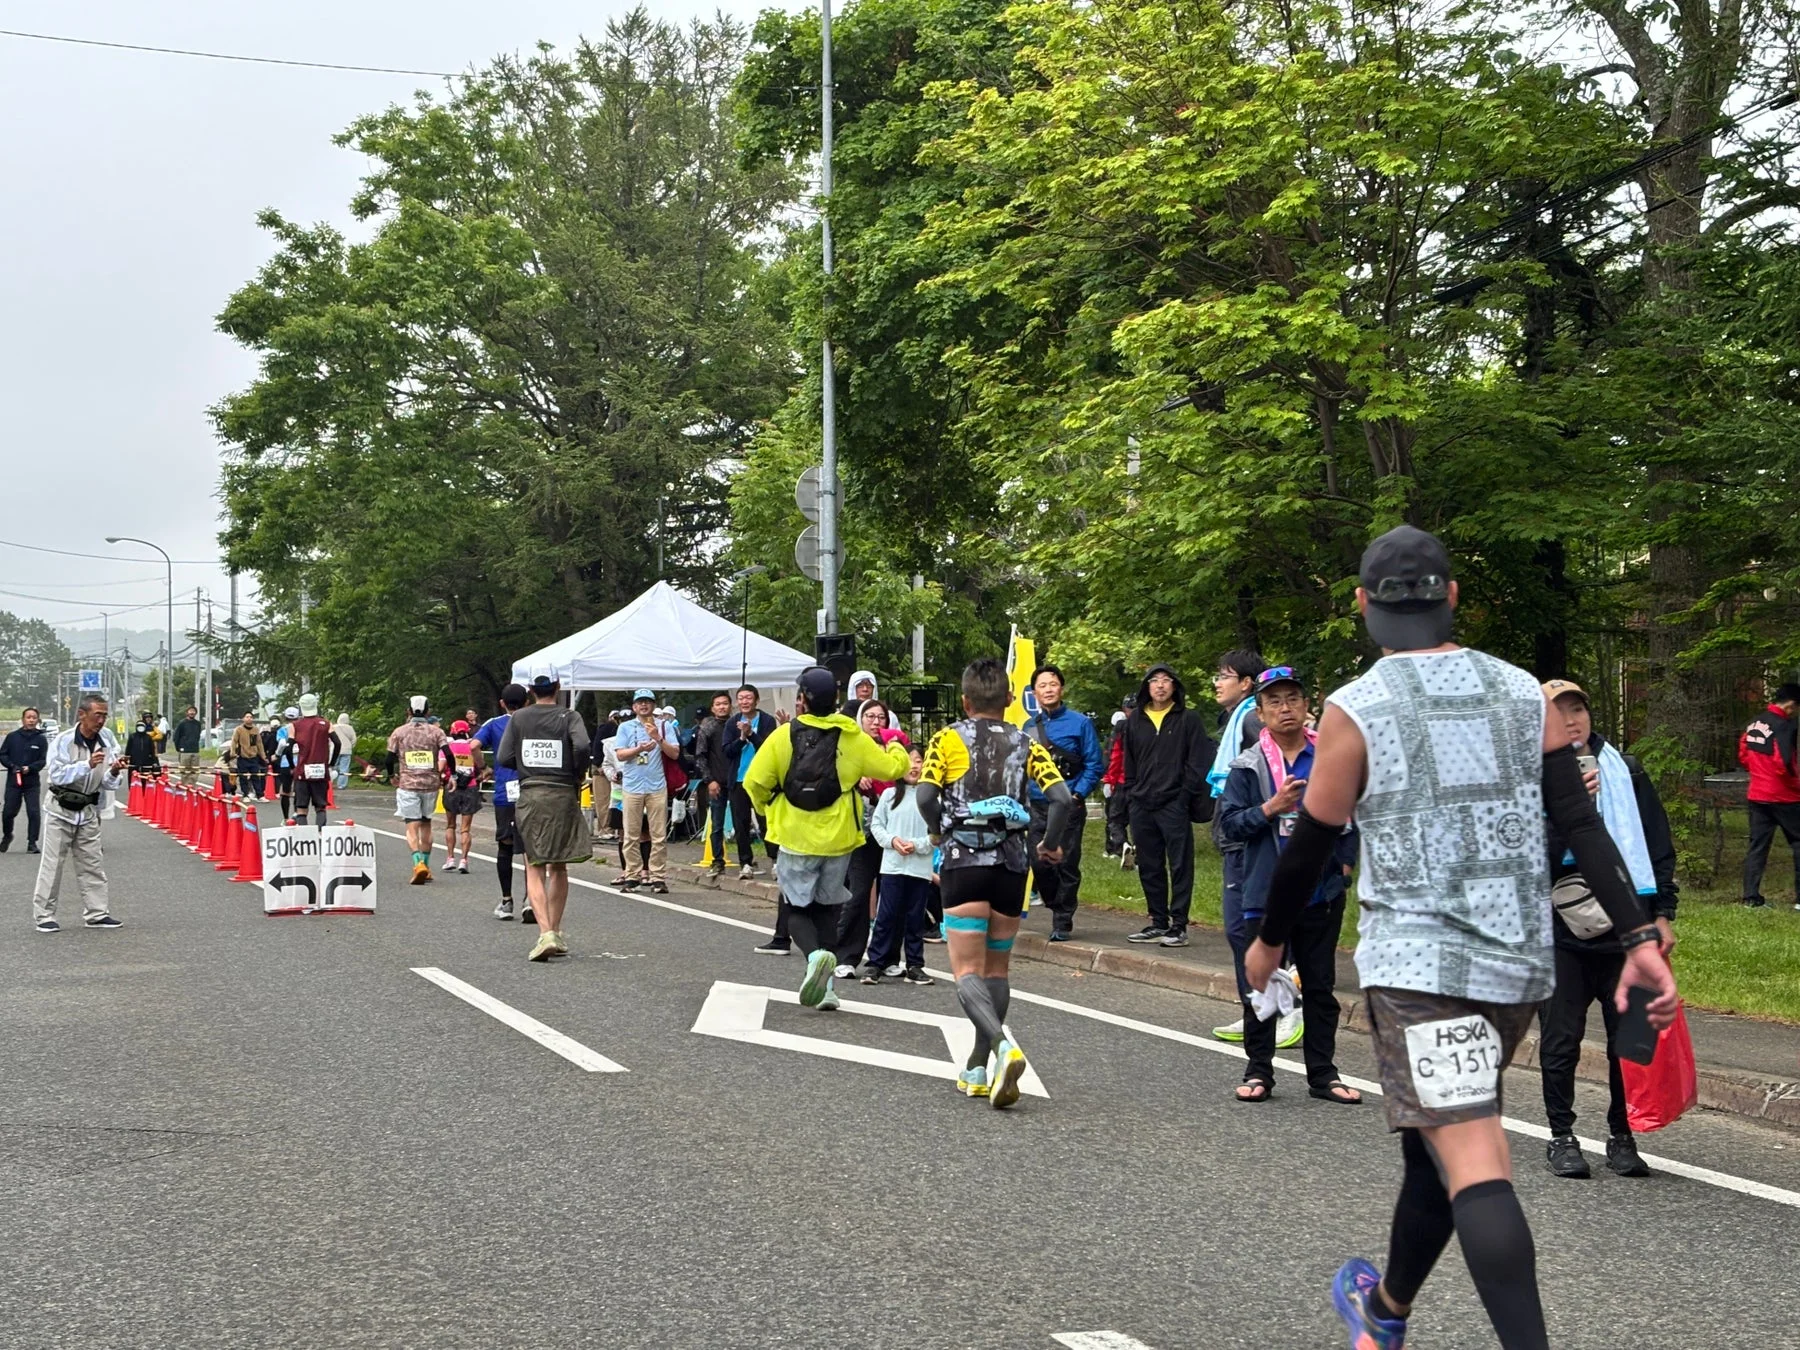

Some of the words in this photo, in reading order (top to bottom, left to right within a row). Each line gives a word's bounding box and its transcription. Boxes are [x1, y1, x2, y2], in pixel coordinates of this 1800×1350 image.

[530, 741, 553, 749] HOKA
[533, 749, 558, 759] 3103
[266, 836, 317, 859] 50km
[325, 836, 374, 858] 100km
[1435, 1021, 1490, 1048] HOKA
[1417, 1057, 1435, 1078] C
